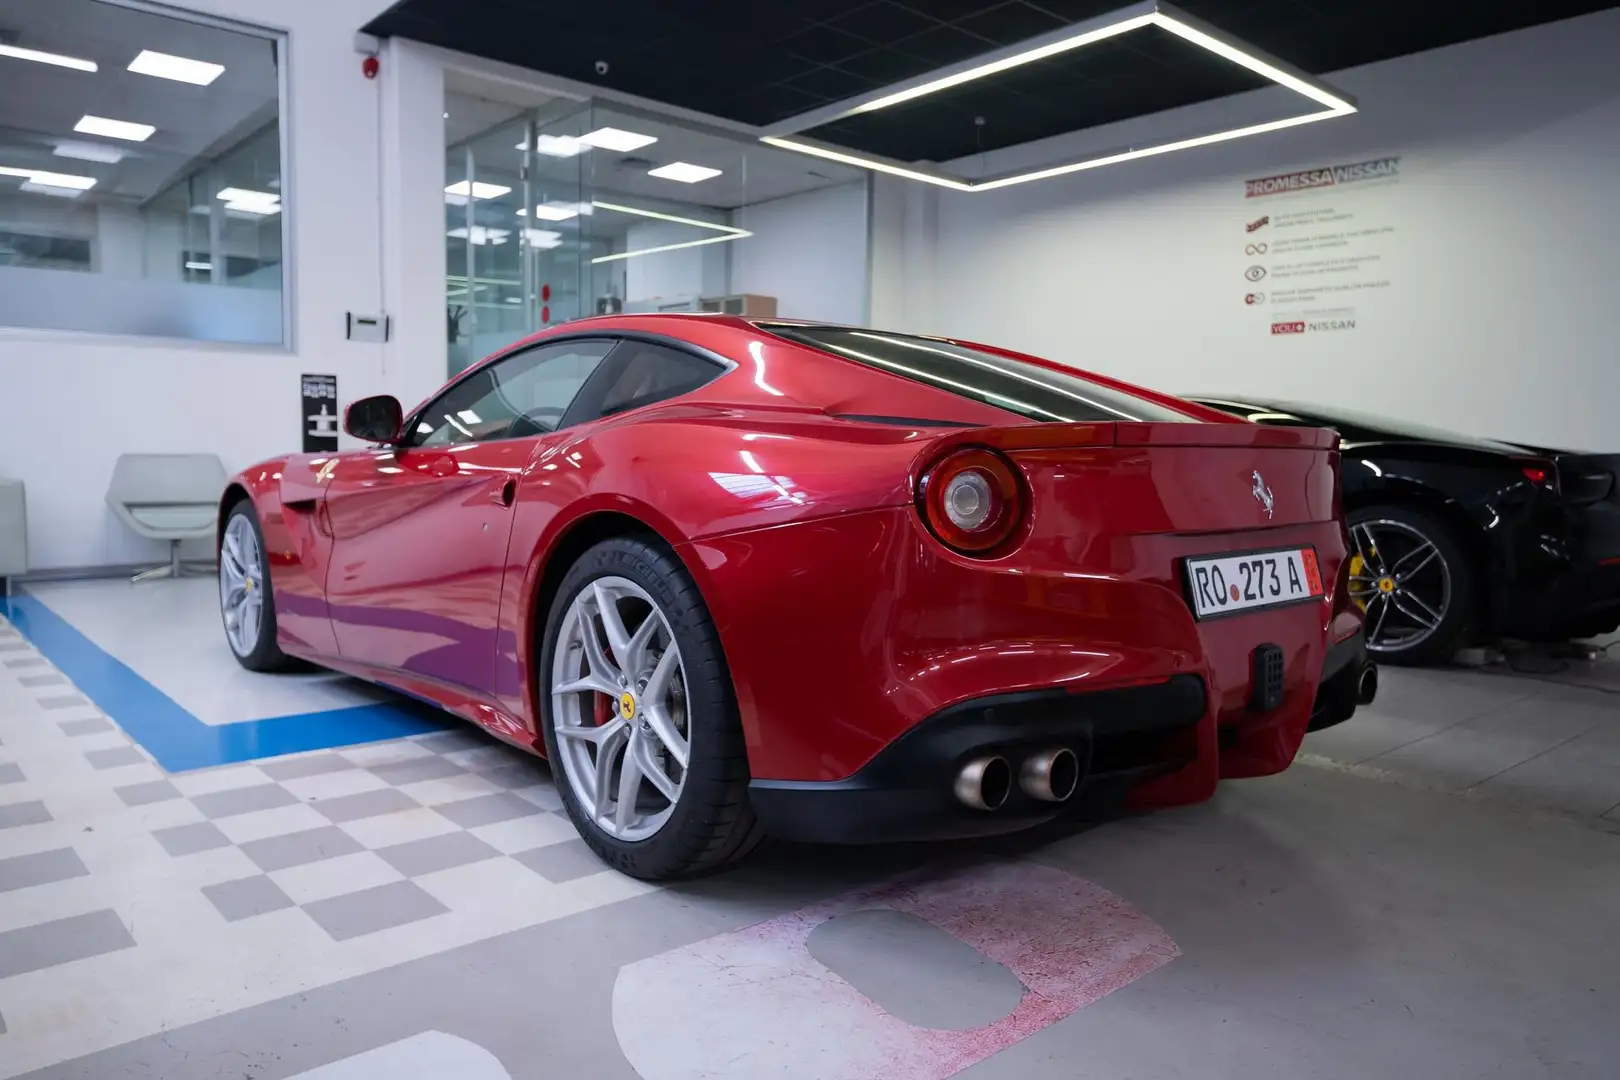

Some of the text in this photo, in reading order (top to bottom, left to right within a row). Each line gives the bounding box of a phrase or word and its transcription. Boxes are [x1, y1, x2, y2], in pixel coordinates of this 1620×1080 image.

[1245, 169, 1333, 196] PROMESSA
[1335, 158, 1400, 182] NISSAN
[1308, 320, 1356, 332] NISSAN
[1195, 564, 1228, 608] RO
[1239, 558, 1281, 601] 273
[1288, 556, 1302, 593] A
